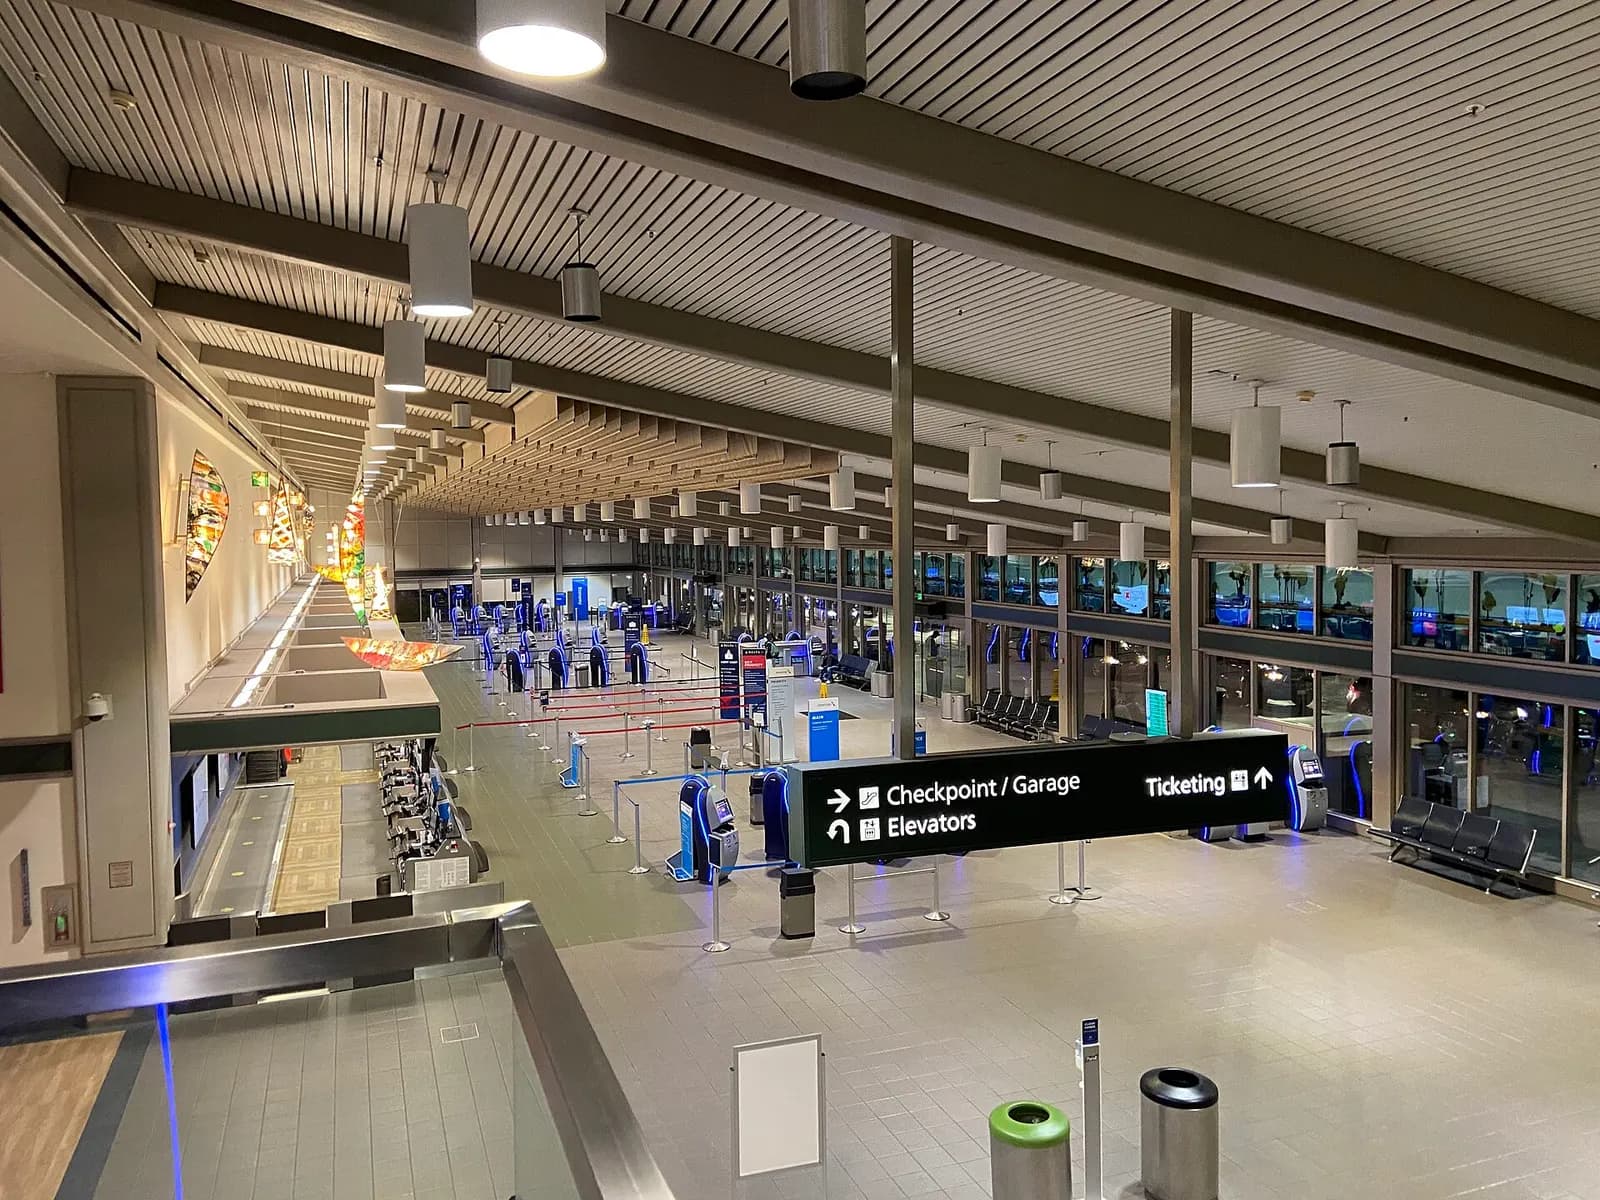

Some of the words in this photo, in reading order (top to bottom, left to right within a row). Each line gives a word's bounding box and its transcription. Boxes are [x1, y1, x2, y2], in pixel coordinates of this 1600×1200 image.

[886, 778, 997, 806] Checkpoint
[1000, 776, 1009, 797] /
[1012, 775, 1081, 796] Garage
[1145, 774, 1225, 797] Ticketing
[887, 813, 977, 838] Elevators
